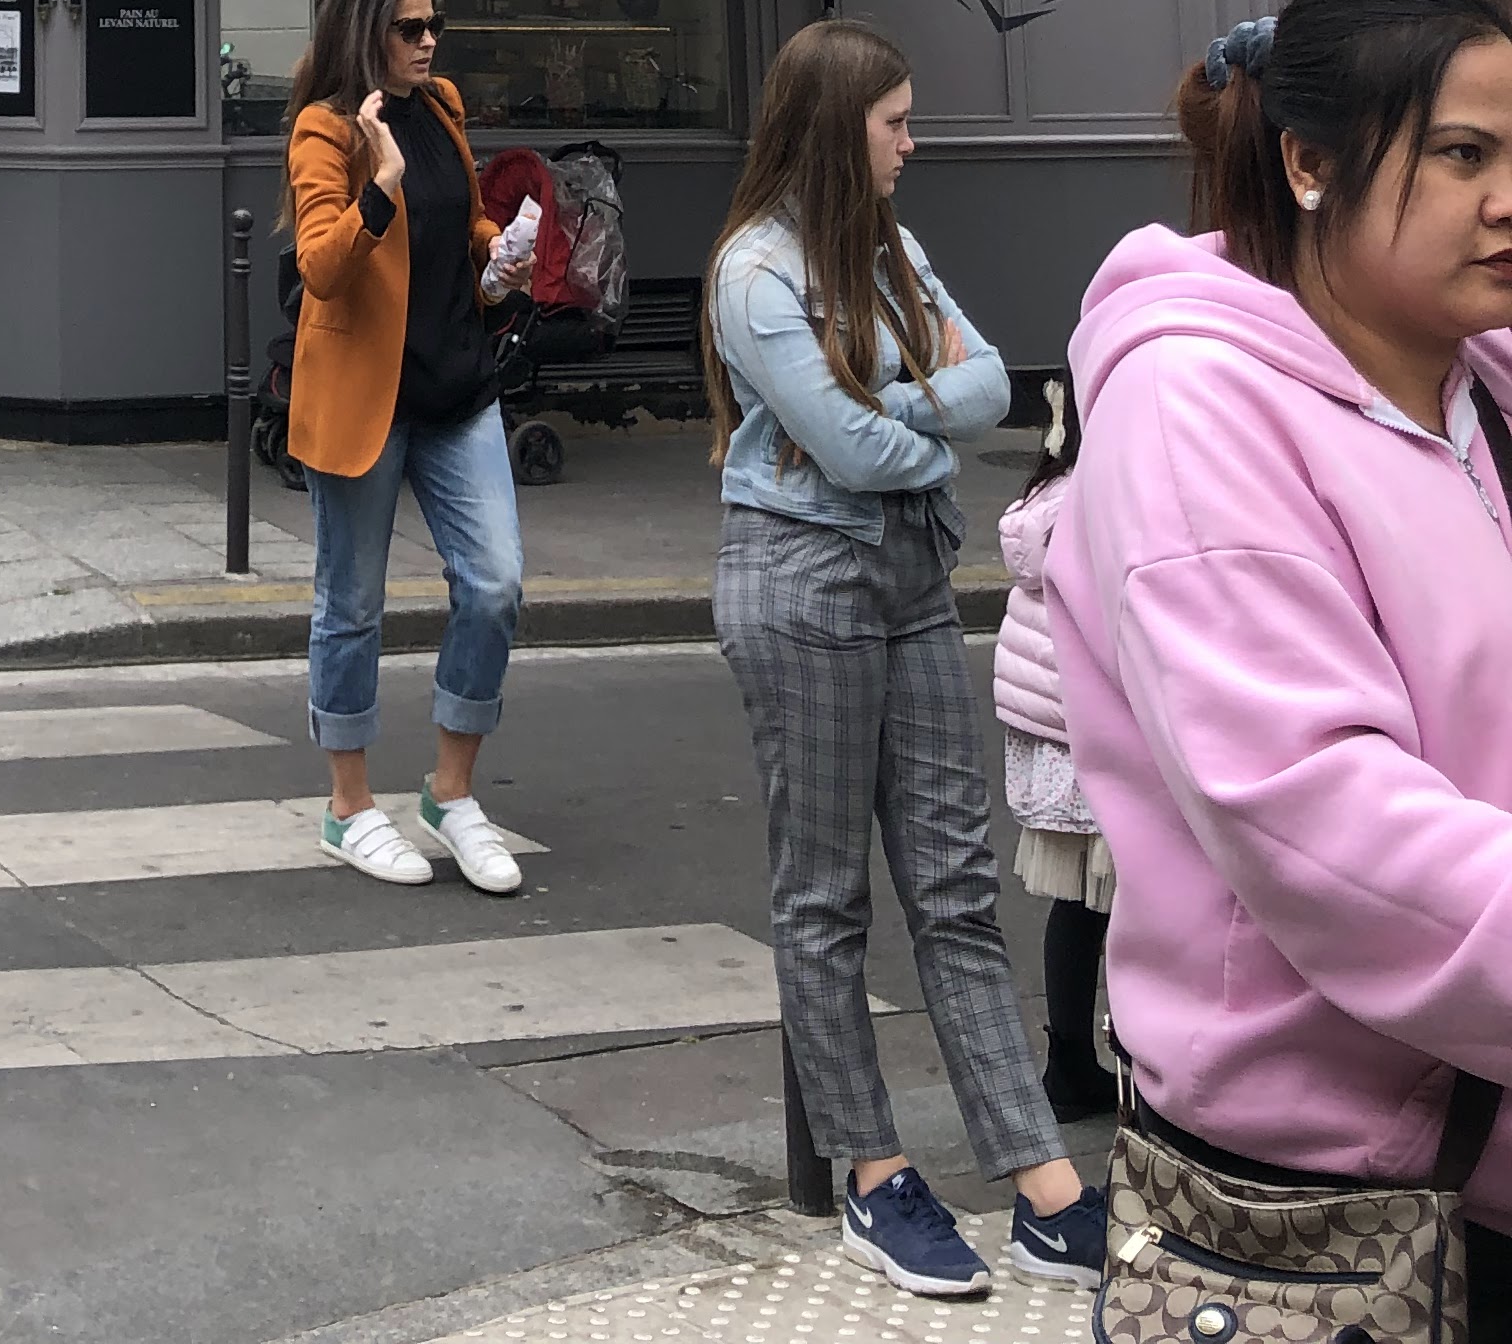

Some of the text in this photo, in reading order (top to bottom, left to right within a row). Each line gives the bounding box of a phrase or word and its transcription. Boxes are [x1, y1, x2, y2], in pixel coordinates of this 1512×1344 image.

[120, 9, 159, 19] PAIN AU
[99, 18, 180, 28] LEVAIN NATUREL
